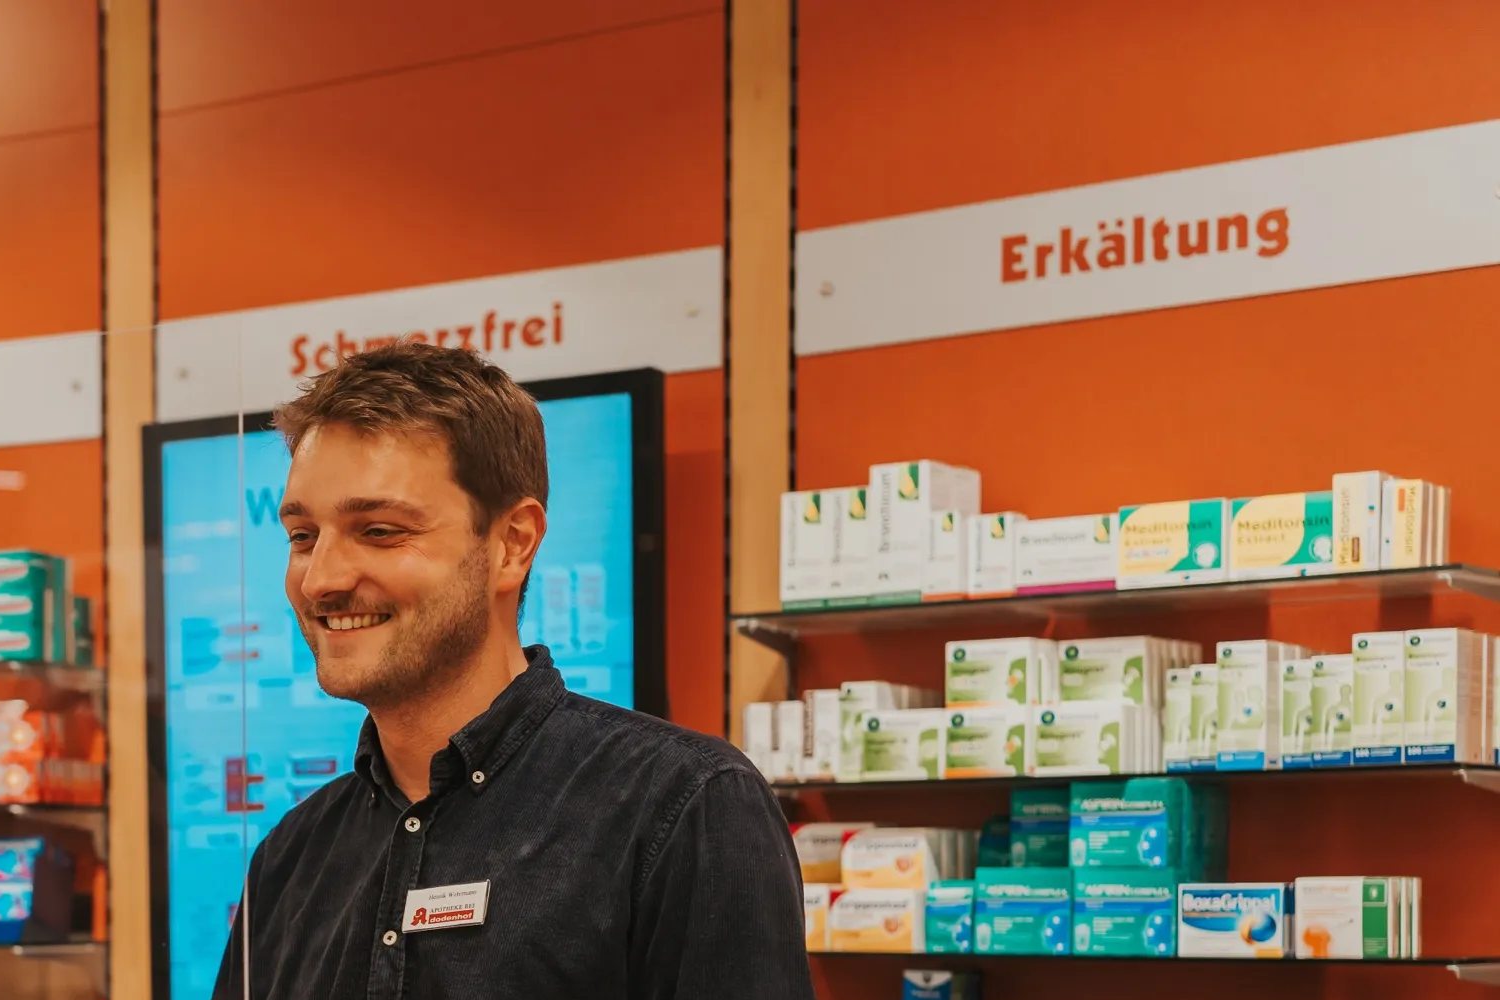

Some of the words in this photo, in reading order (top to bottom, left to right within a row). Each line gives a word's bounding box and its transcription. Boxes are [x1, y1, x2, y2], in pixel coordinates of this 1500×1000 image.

[1001, 207, 1291, 283] Erkältung
[1237, 515, 1331, 532] Meditonsin
[1182, 892, 1276, 914] BoxaGrippal
[429, 912, 473, 924] dodenhof
